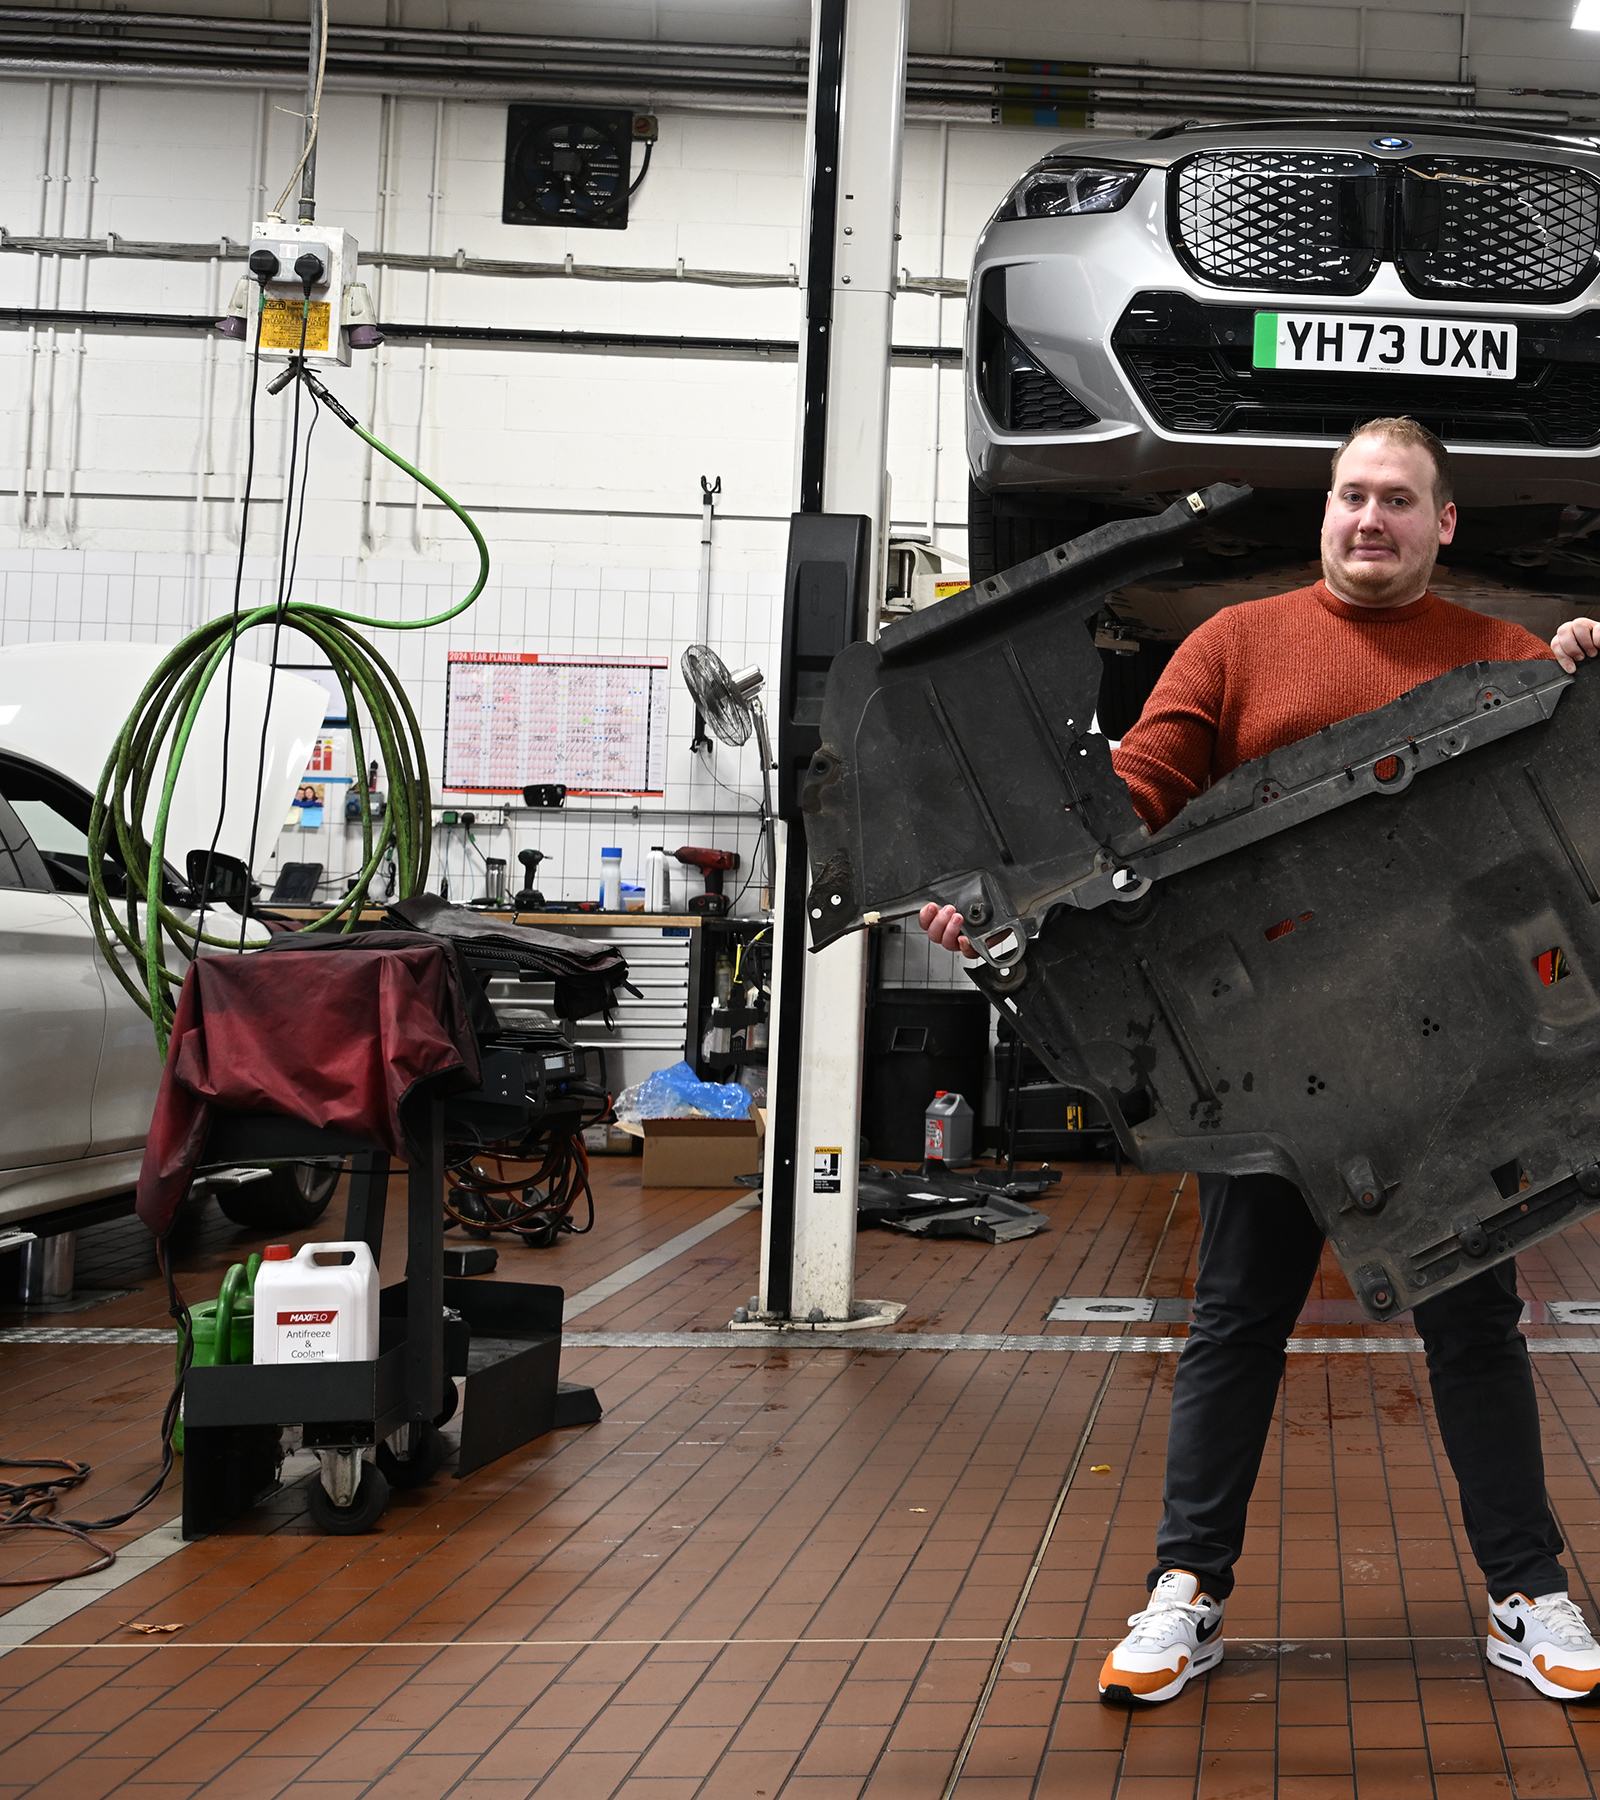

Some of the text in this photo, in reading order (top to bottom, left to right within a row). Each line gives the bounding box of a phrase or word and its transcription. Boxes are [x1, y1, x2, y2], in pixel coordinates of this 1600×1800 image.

[1286, 321, 1509, 370] YH73 UXN
[449, 652, 522, 662] 2024 YEAR PLANNER
[290, 1313, 328, 1322] MAXIFLO
[286, 1330, 331, 1338] Antifreeze
[304, 1340, 312, 1348] &
[291, 1349, 325, 1358] Coolant
